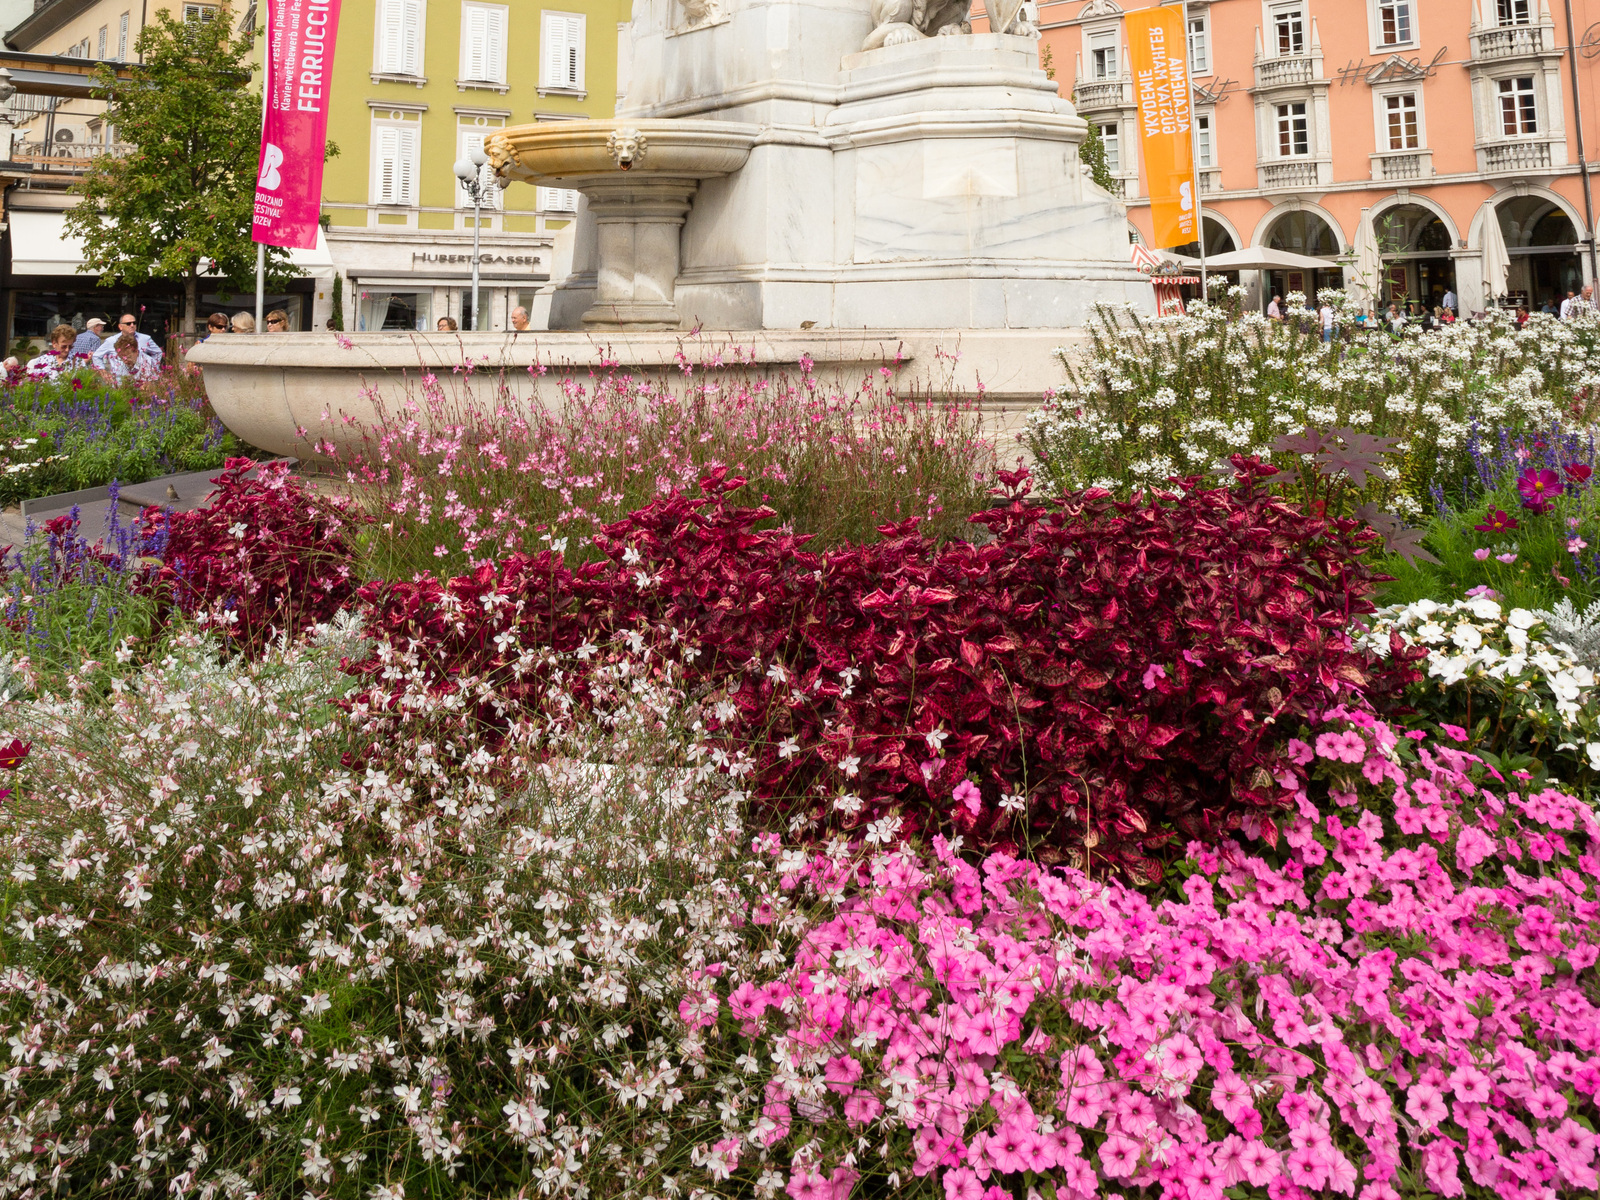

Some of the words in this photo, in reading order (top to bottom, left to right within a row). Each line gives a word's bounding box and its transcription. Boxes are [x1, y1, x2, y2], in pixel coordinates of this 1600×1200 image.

[280, 31, 298, 111] Klavierwettbewerb
[290, 13, 300, 29] und
[254, 192, 283, 207] BOLZANO
